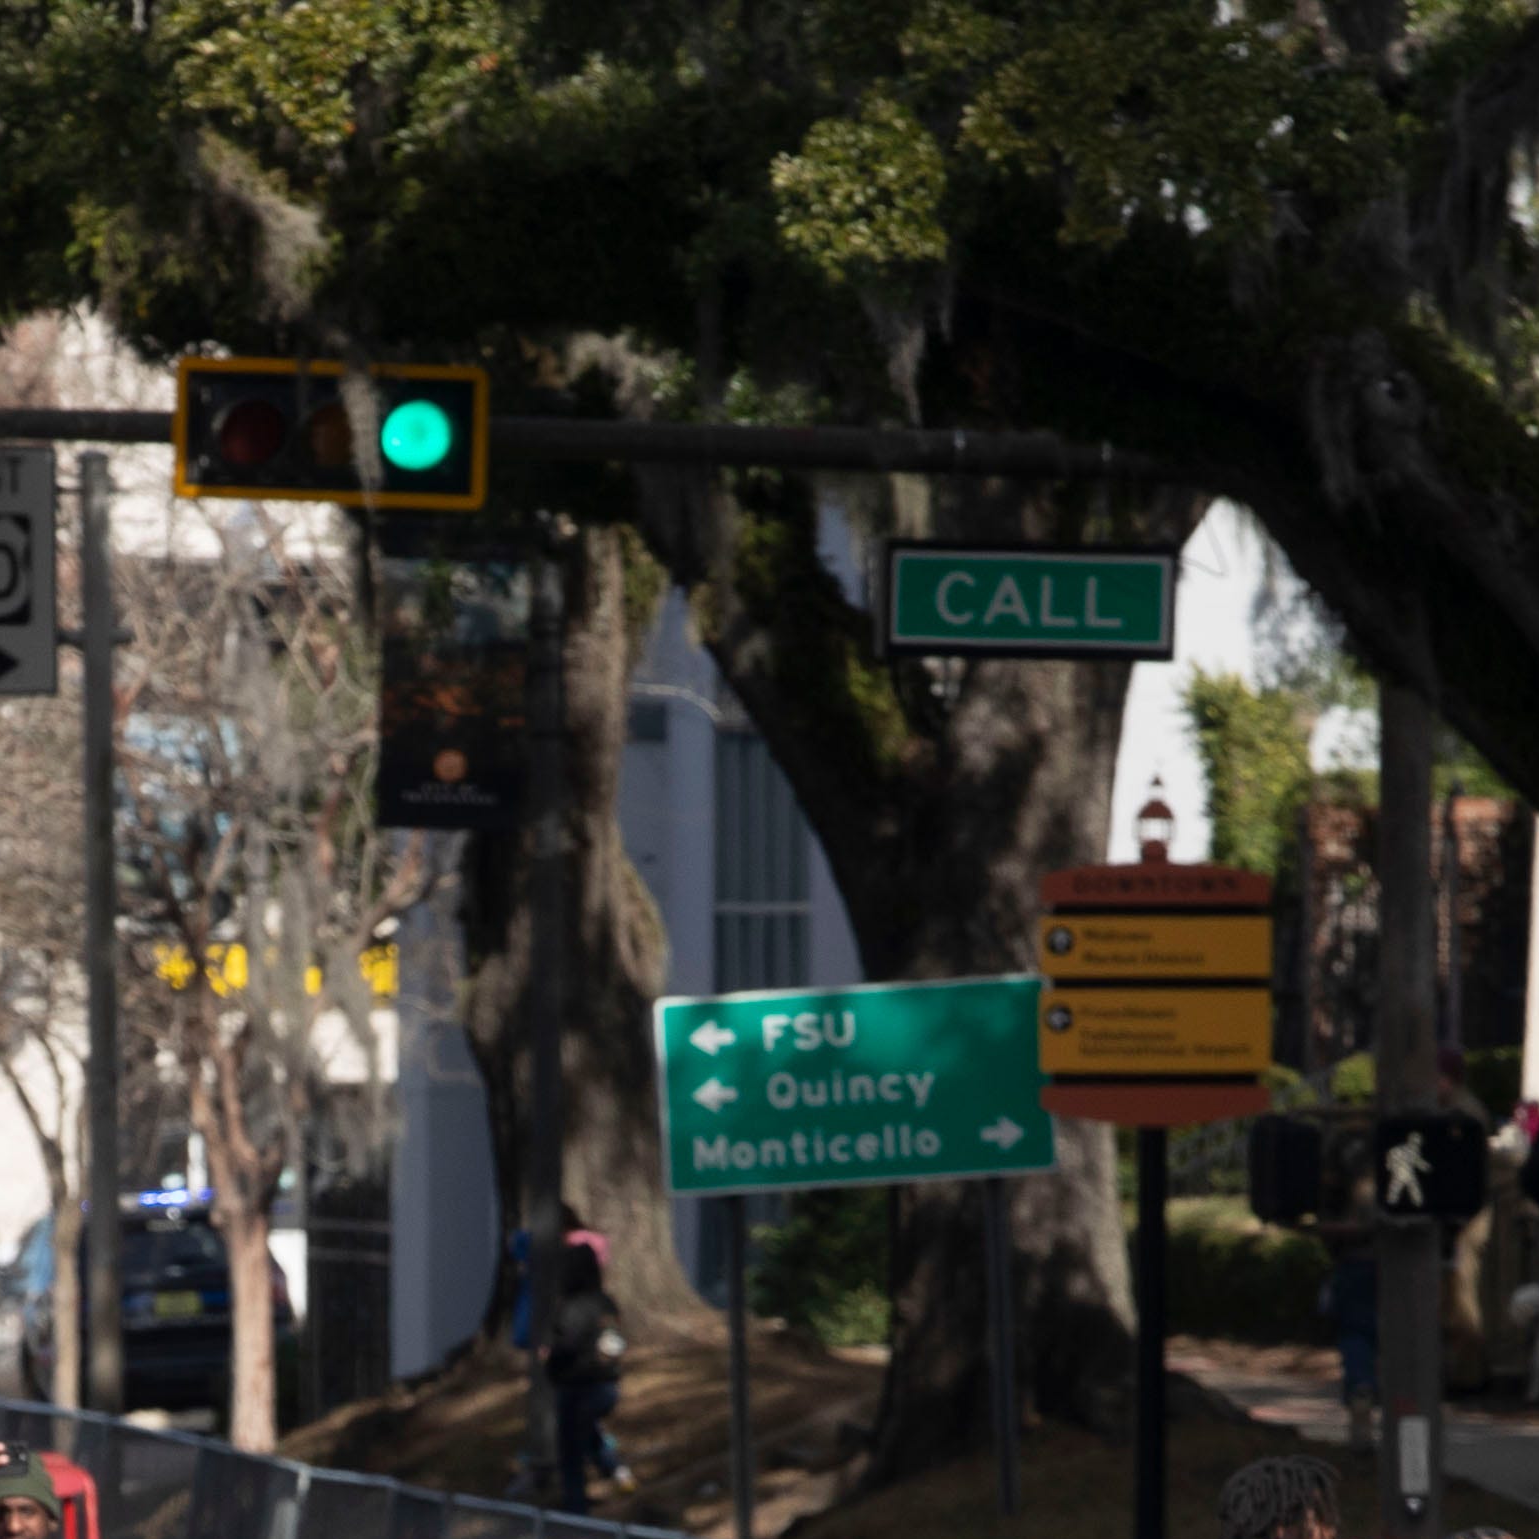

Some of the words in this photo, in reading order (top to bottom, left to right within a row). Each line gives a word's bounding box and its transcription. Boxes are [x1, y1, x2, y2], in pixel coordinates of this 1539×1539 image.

[935, 570, 1123, 629] CALL
[761, 1010, 857, 1052] FSU
[766, 1068, 935, 1111] Quincy
[692, 1123, 942, 1172] Monticello
